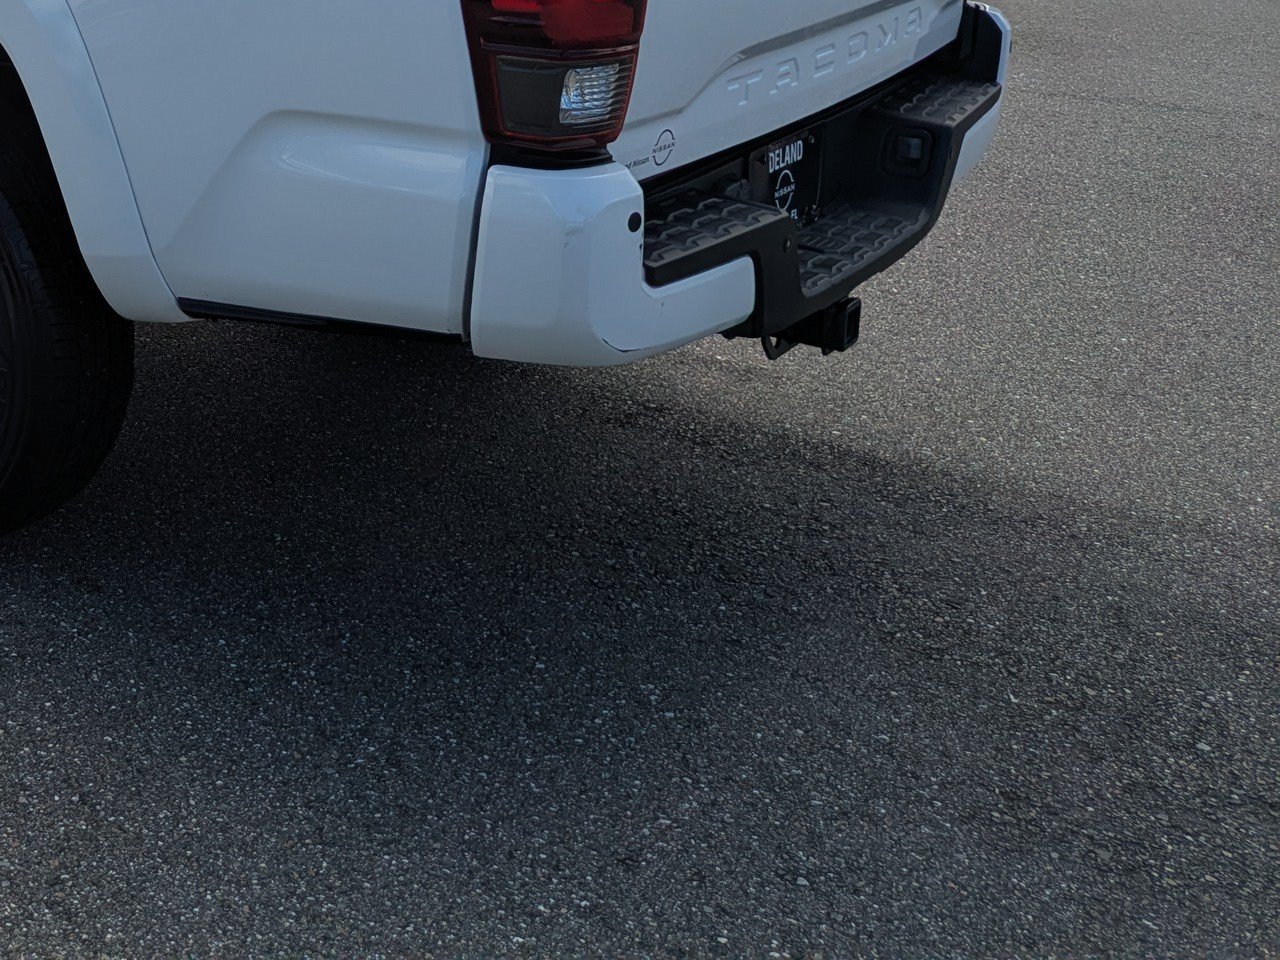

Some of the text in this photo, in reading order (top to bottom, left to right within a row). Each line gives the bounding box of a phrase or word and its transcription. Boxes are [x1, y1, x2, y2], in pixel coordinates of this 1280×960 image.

[726, 6, 921, 107] TACOMA
[652, 140, 676, 155] NISSAN
[768, 140, 804, 174] DELAND
[774, 182, 796, 199] NISSAN
